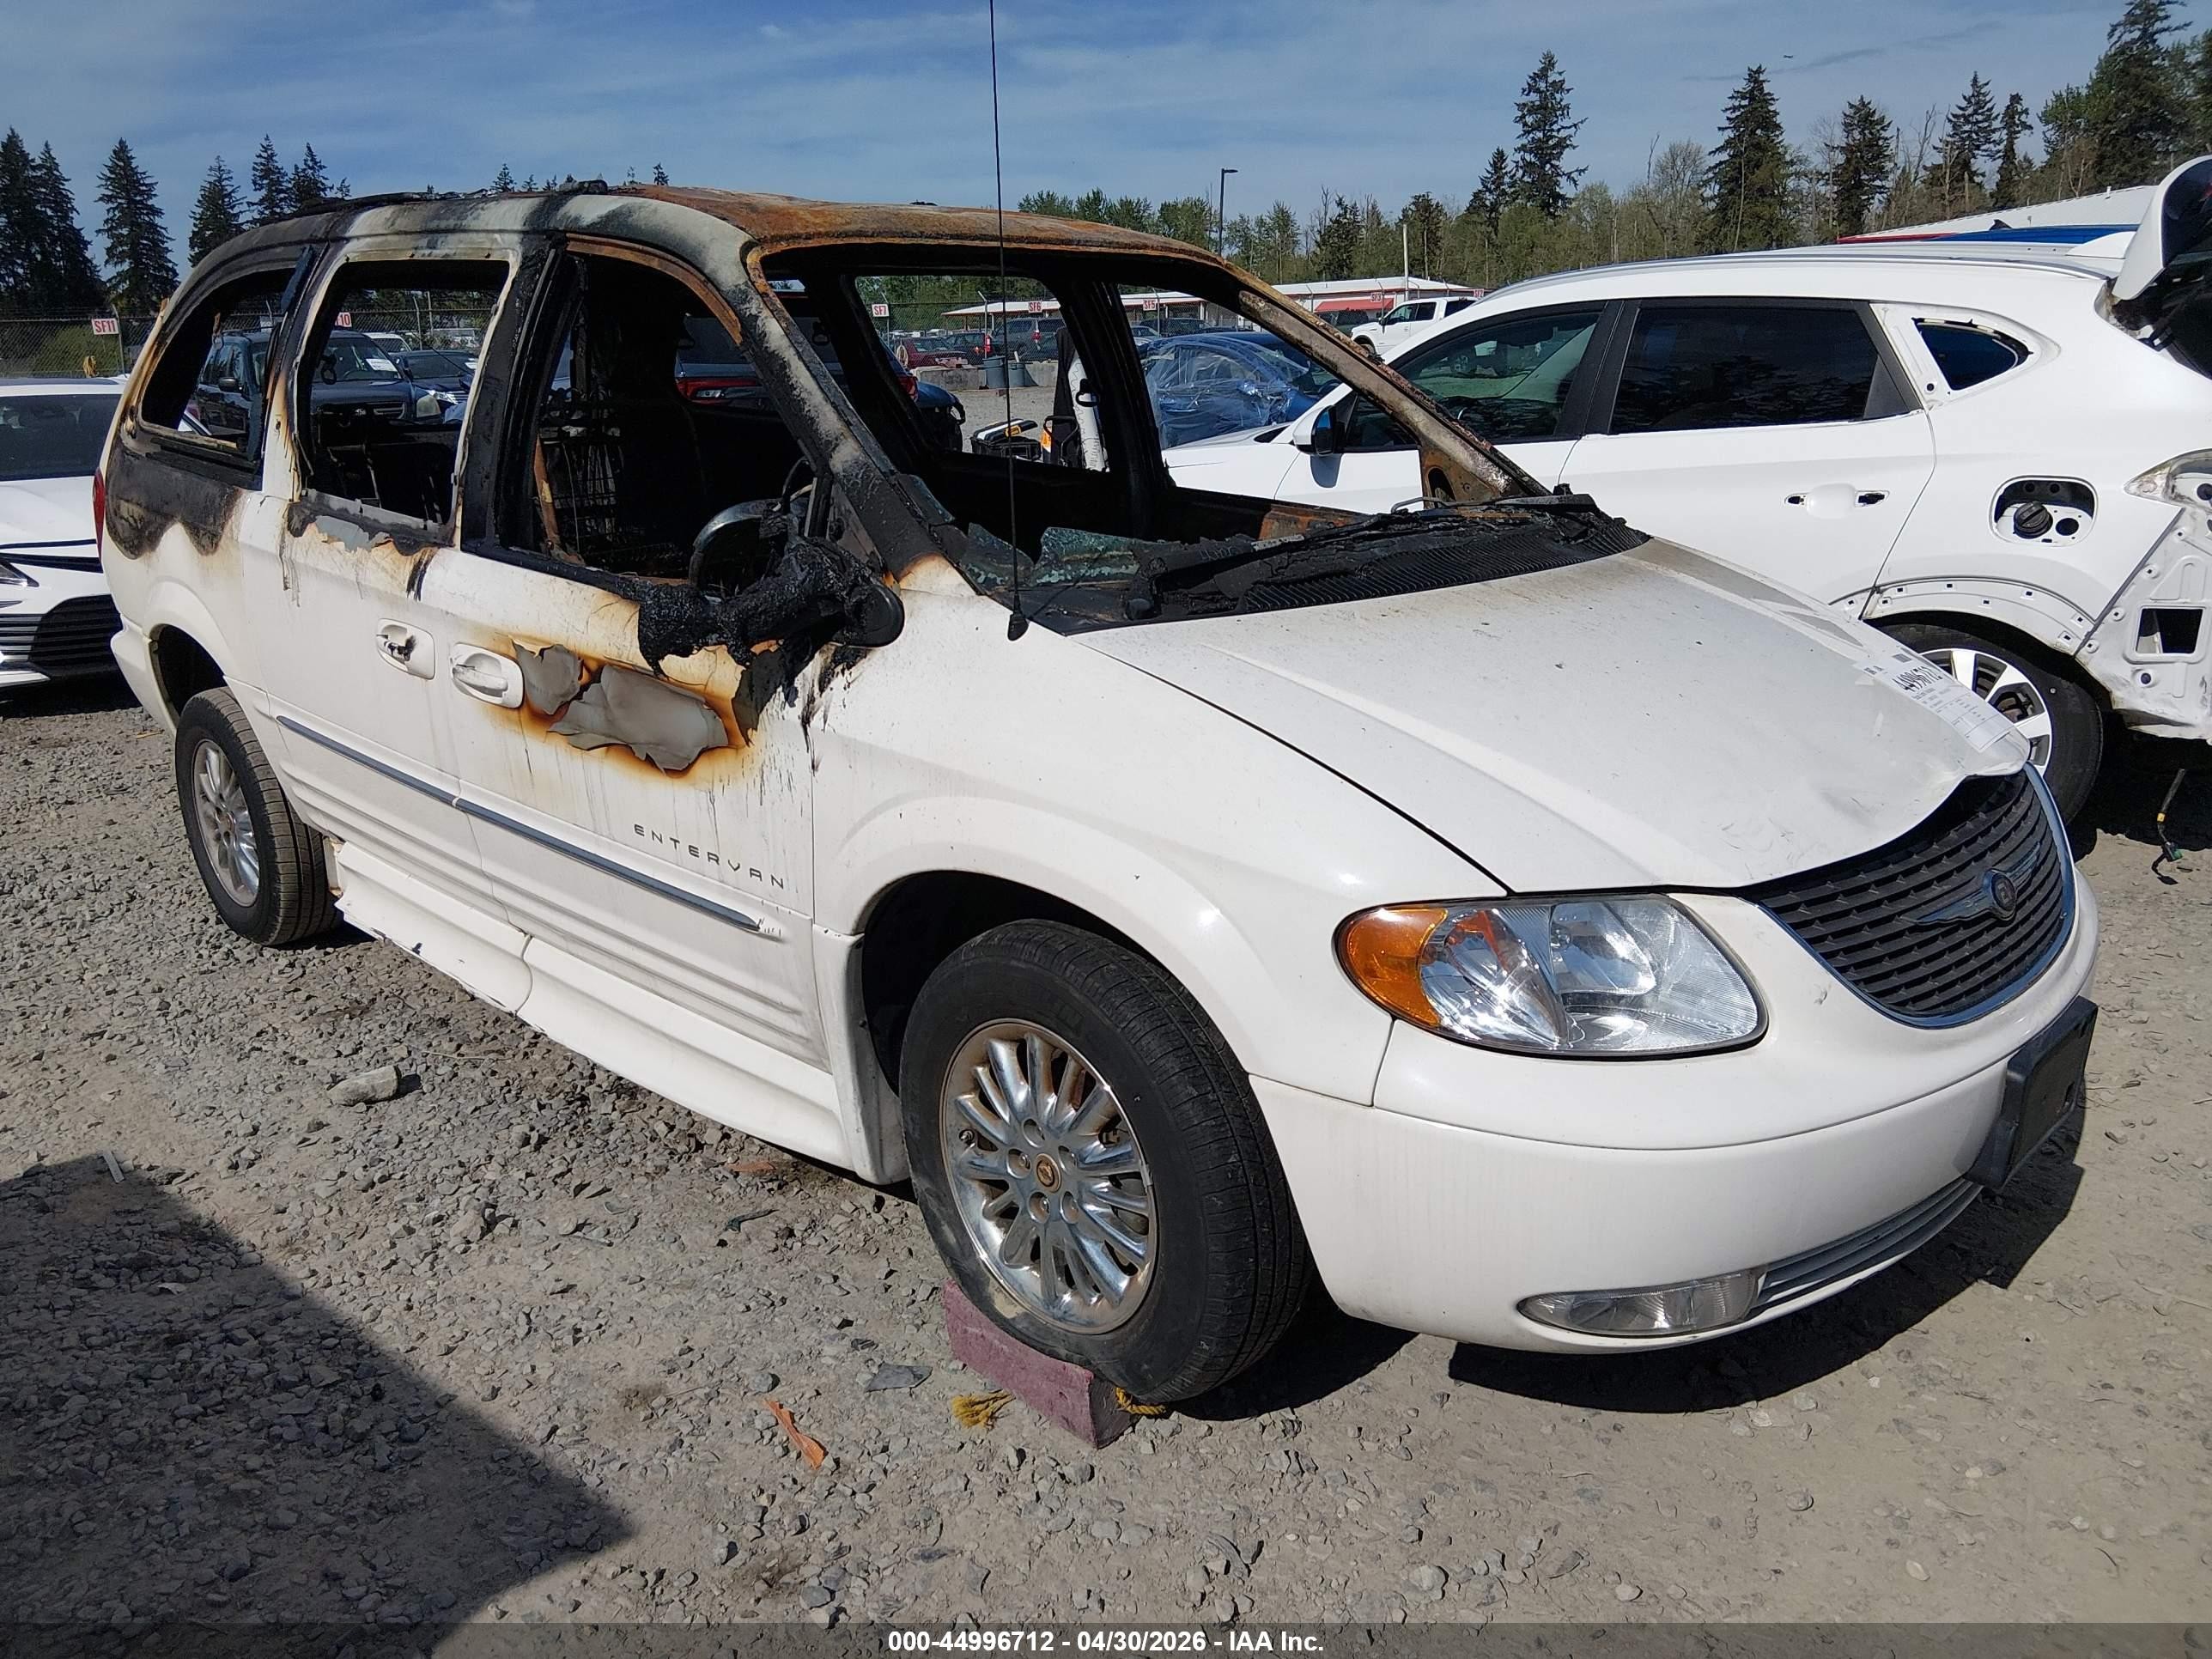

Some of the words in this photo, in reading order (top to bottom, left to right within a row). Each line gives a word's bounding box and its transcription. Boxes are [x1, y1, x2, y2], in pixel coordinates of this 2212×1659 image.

[873, 305, 887, 316] SF7
[1029, 301, 1042, 312] SF6
[1144, 301, 1156, 310] SF5
[94, 319, 116, 333] SF11
[634, 823, 784, 890] ENTERVAN
